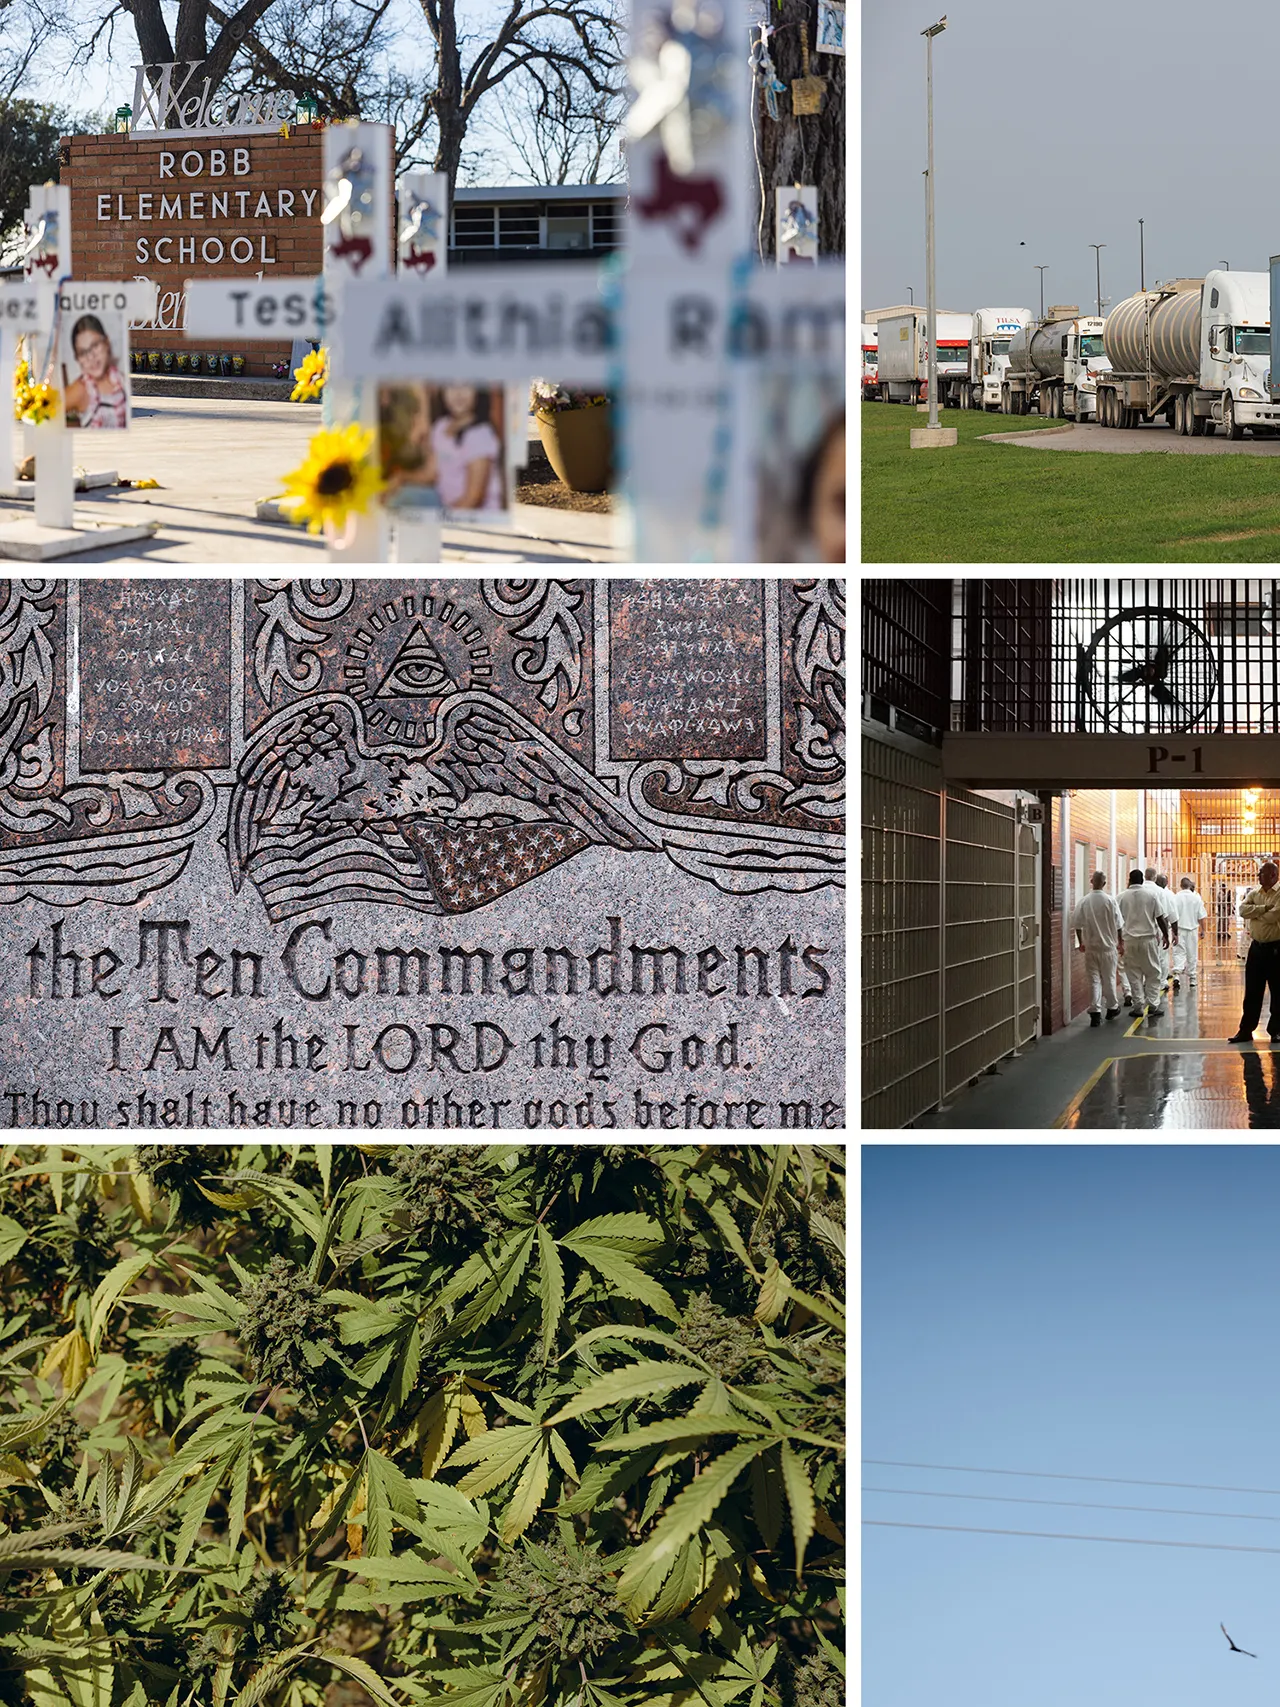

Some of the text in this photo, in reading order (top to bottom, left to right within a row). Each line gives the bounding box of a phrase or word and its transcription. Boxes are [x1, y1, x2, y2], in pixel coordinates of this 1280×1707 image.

[131, 60, 295, 132] Welcome
[159, 149, 251, 179] ROBB
[97, 189, 318, 221] ELEMENTARY
[136, 236, 277, 265] SCHOOL
[228, 290, 337, 328] Tess
[1147, 746, 1205, 773] P-1
[26, 915, 831, 1003] the Ten Commandments
[107, 1016, 752, 1082] I AM the LORD thy God.
[3, 1088, 99, 1128] Thou
[117, 1090, 212, 1127] shalt
[226, 1090, 322, 1127] have
[337, 1098, 383, 1127] no
[401, 1090, 511, 1128] other
[523, 1092, 617, 1128] gods
[634, 1089, 767, 1128] before
